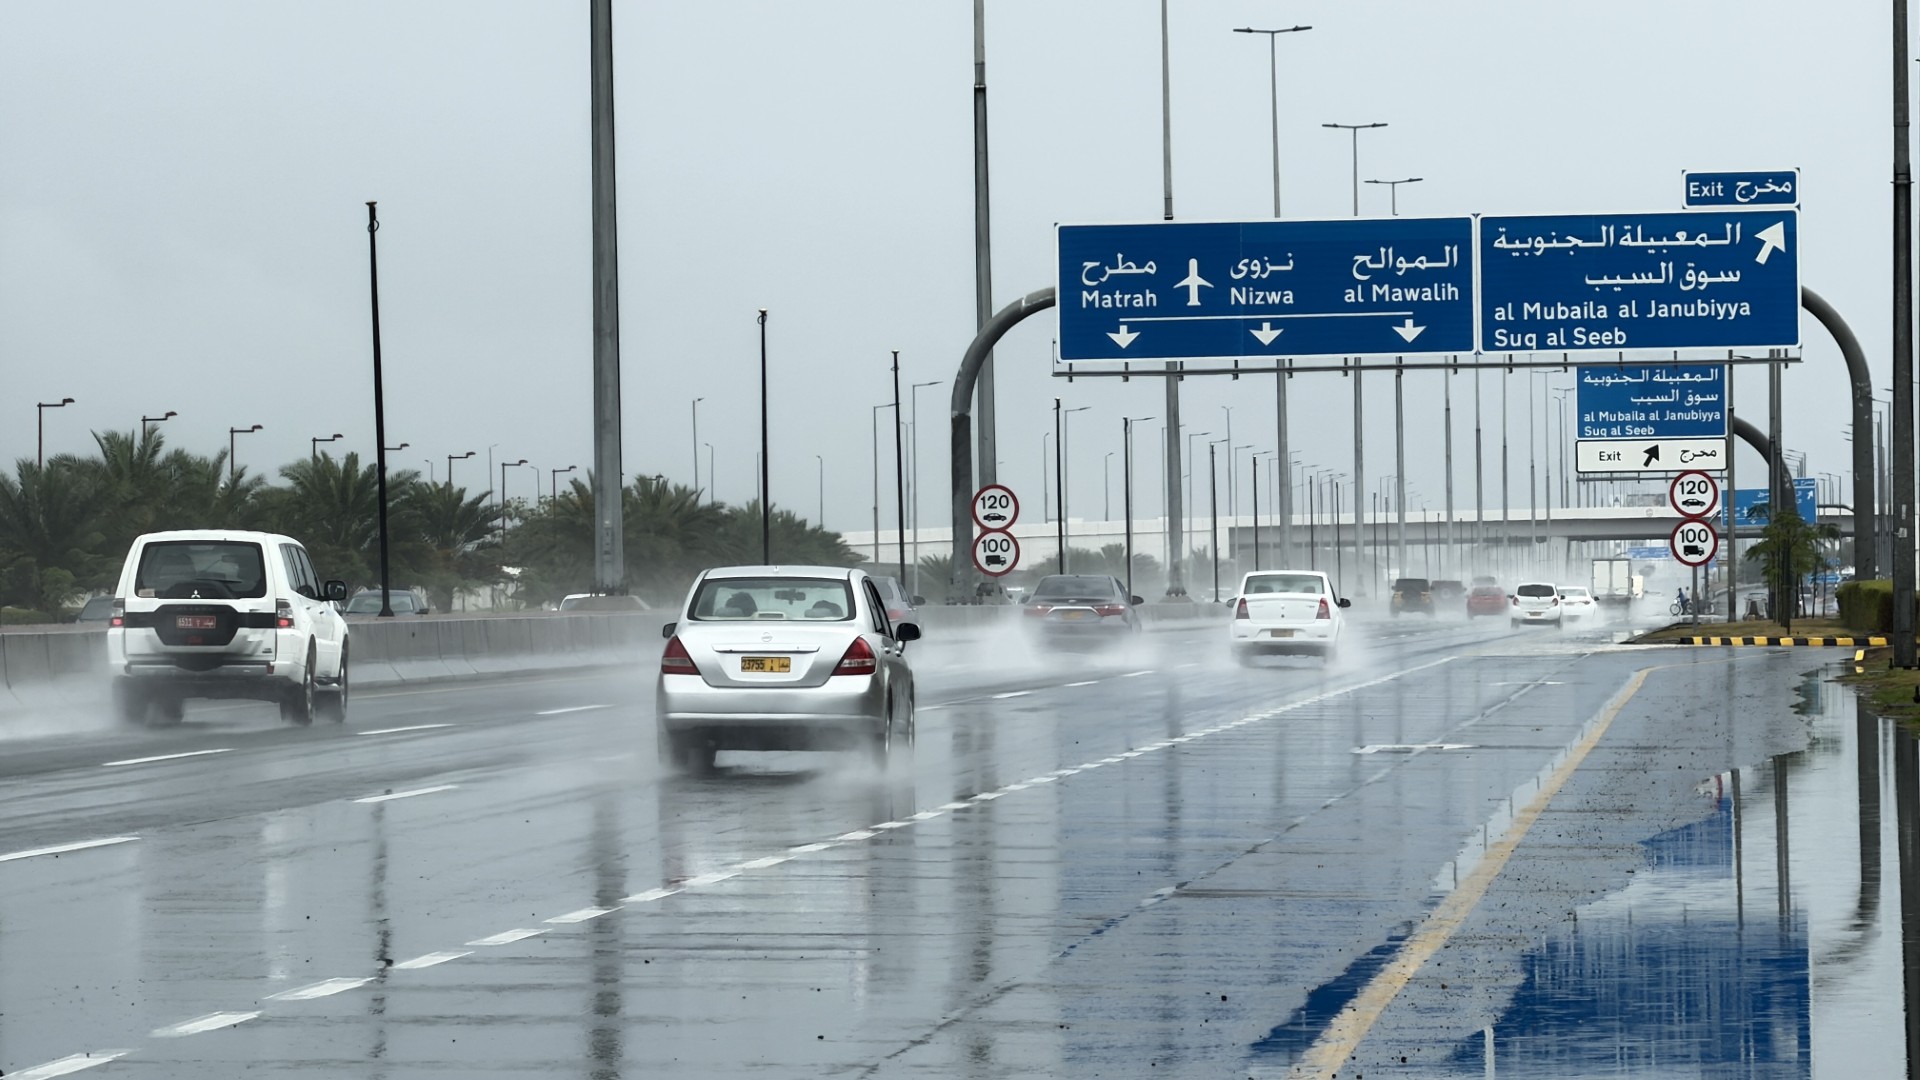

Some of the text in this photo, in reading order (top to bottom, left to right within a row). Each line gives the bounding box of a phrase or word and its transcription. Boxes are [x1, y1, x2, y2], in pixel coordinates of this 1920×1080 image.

[1689, 181, 1724, 197] Exit
[1735, 178, 1792, 202] مخرج
[1493, 221, 1741, 256] المعبيلة الجنوبية
[1081, 252, 1157, 285] مطرح
[1230, 252, 1294, 280] نزوى
[1352, 244, 1458, 281] الموالح
[1585, 261, 1741, 291] سوق السيب
[1082, 289, 1157, 309] Matrah
[1230, 286, 1294, 306] Nizwa
[1344, 282, 1459, 303] al Mawalih
[1494, 299, 1751, 321] al Mubaila al Janubiyya
[1494, 327, 1627, 349] Suq al Seeb
[1583, 368, 1719, 387] المعبيلة الجنوبية
[1630, 388, 1719, 406] سوق السيب
[1583, 408, 1721, 422] al Mubaila al Janubiyya
[1584, 425, 1655, 437] Suq al Seeb
[1599, 451, 1622, 462] Exit
[1680, 448, 1717, 463] مخرج
[1679, 480, 1708, 495] 120
[980, 495, 1009, 510] 120
[981, 538, 1010, 553] 100
[1680, 529, 1708, 543] 100
